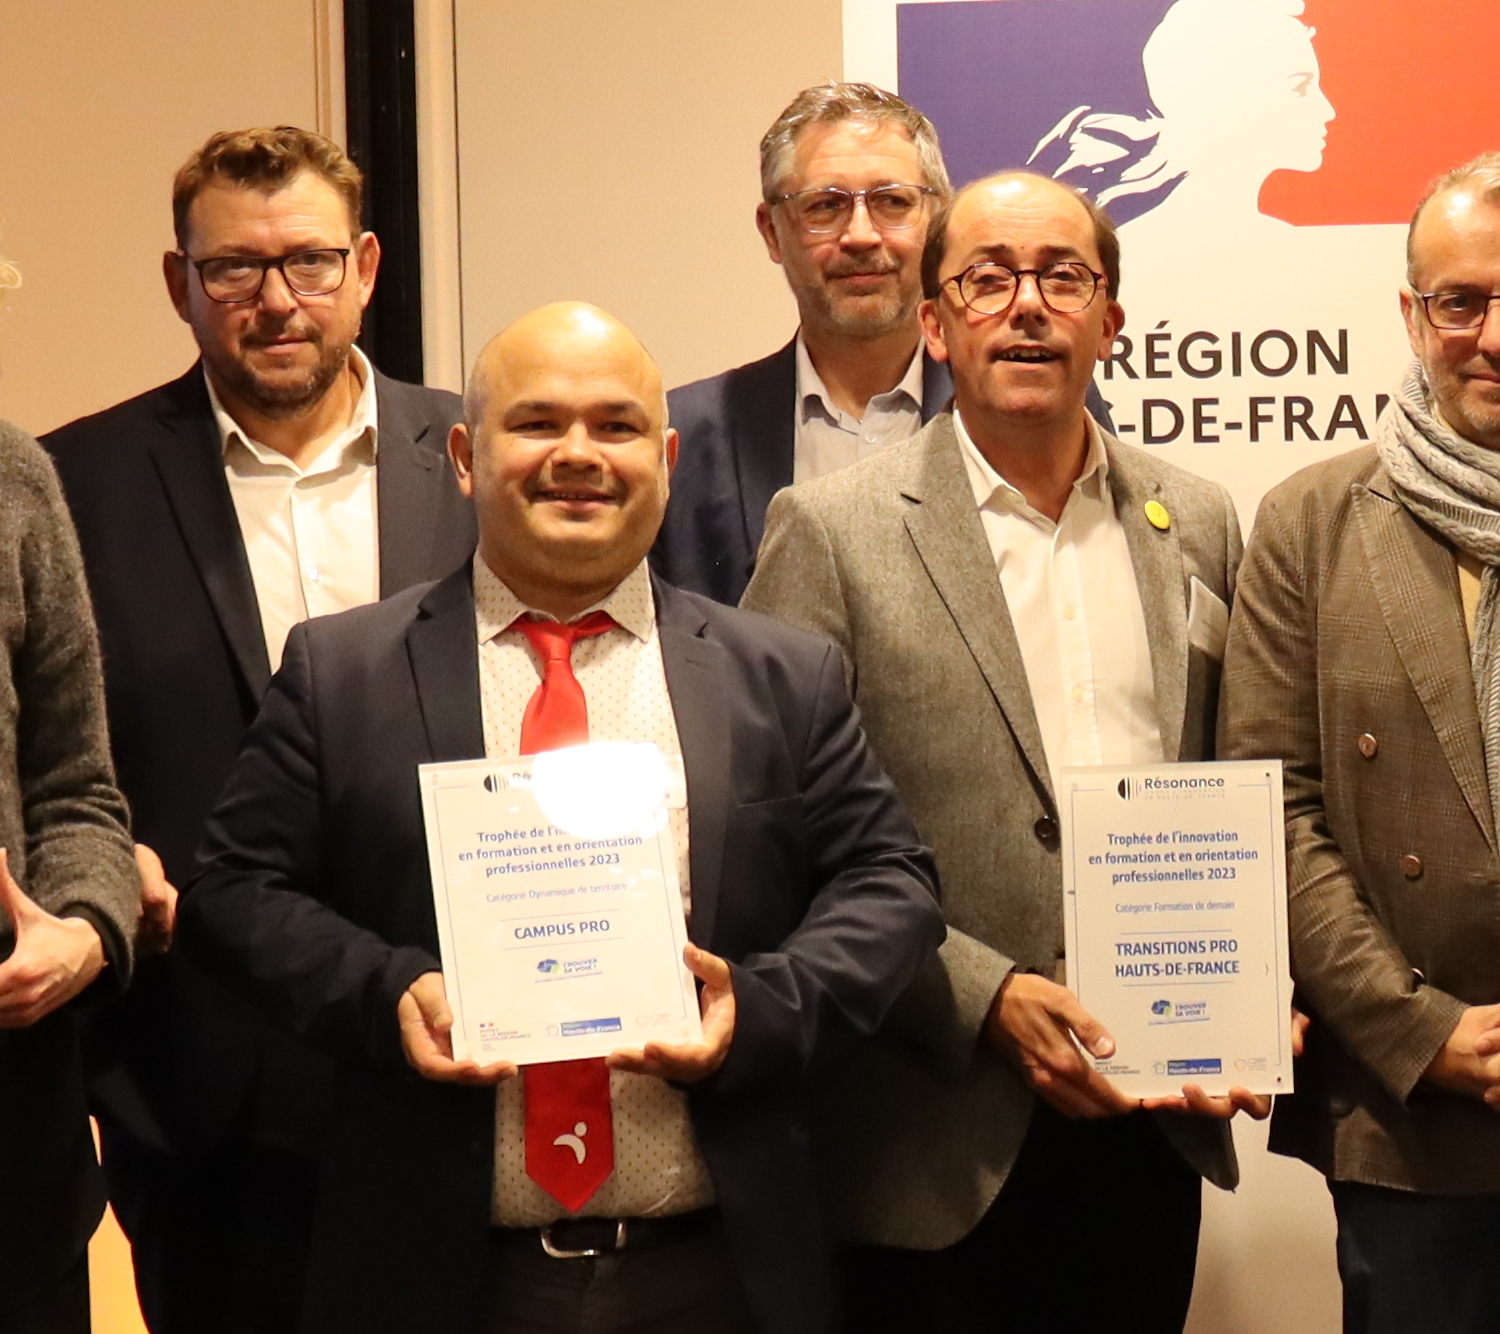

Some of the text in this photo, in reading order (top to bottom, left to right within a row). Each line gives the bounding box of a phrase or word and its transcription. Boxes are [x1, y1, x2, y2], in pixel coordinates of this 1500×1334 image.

[1103, 319, 1348, 380] RÉGION
[1144, 777, 1224, 789] Résonance
[476, 830, 526, 843] Trophée
[530, 827, 543, 837] de
[1107, 832, 1152, 847] Trophée
[1156, 832, 1169, 843] de
[458, 837, 642, 861] en formation et en orientation
[1088, 847, 1258, 864] en formation et en orientation
[485, 853, 619, 877] professionnelles 2023
[1112, 867, 1235, 885] professionnelles 2023
[514, 920, 609, 939] CAMPUS PRO
[1115, 939, 1237, 956] TRANSITIONS PRO
[1115, 960, 1239, 977] HAUTS-DE-FRANCE
